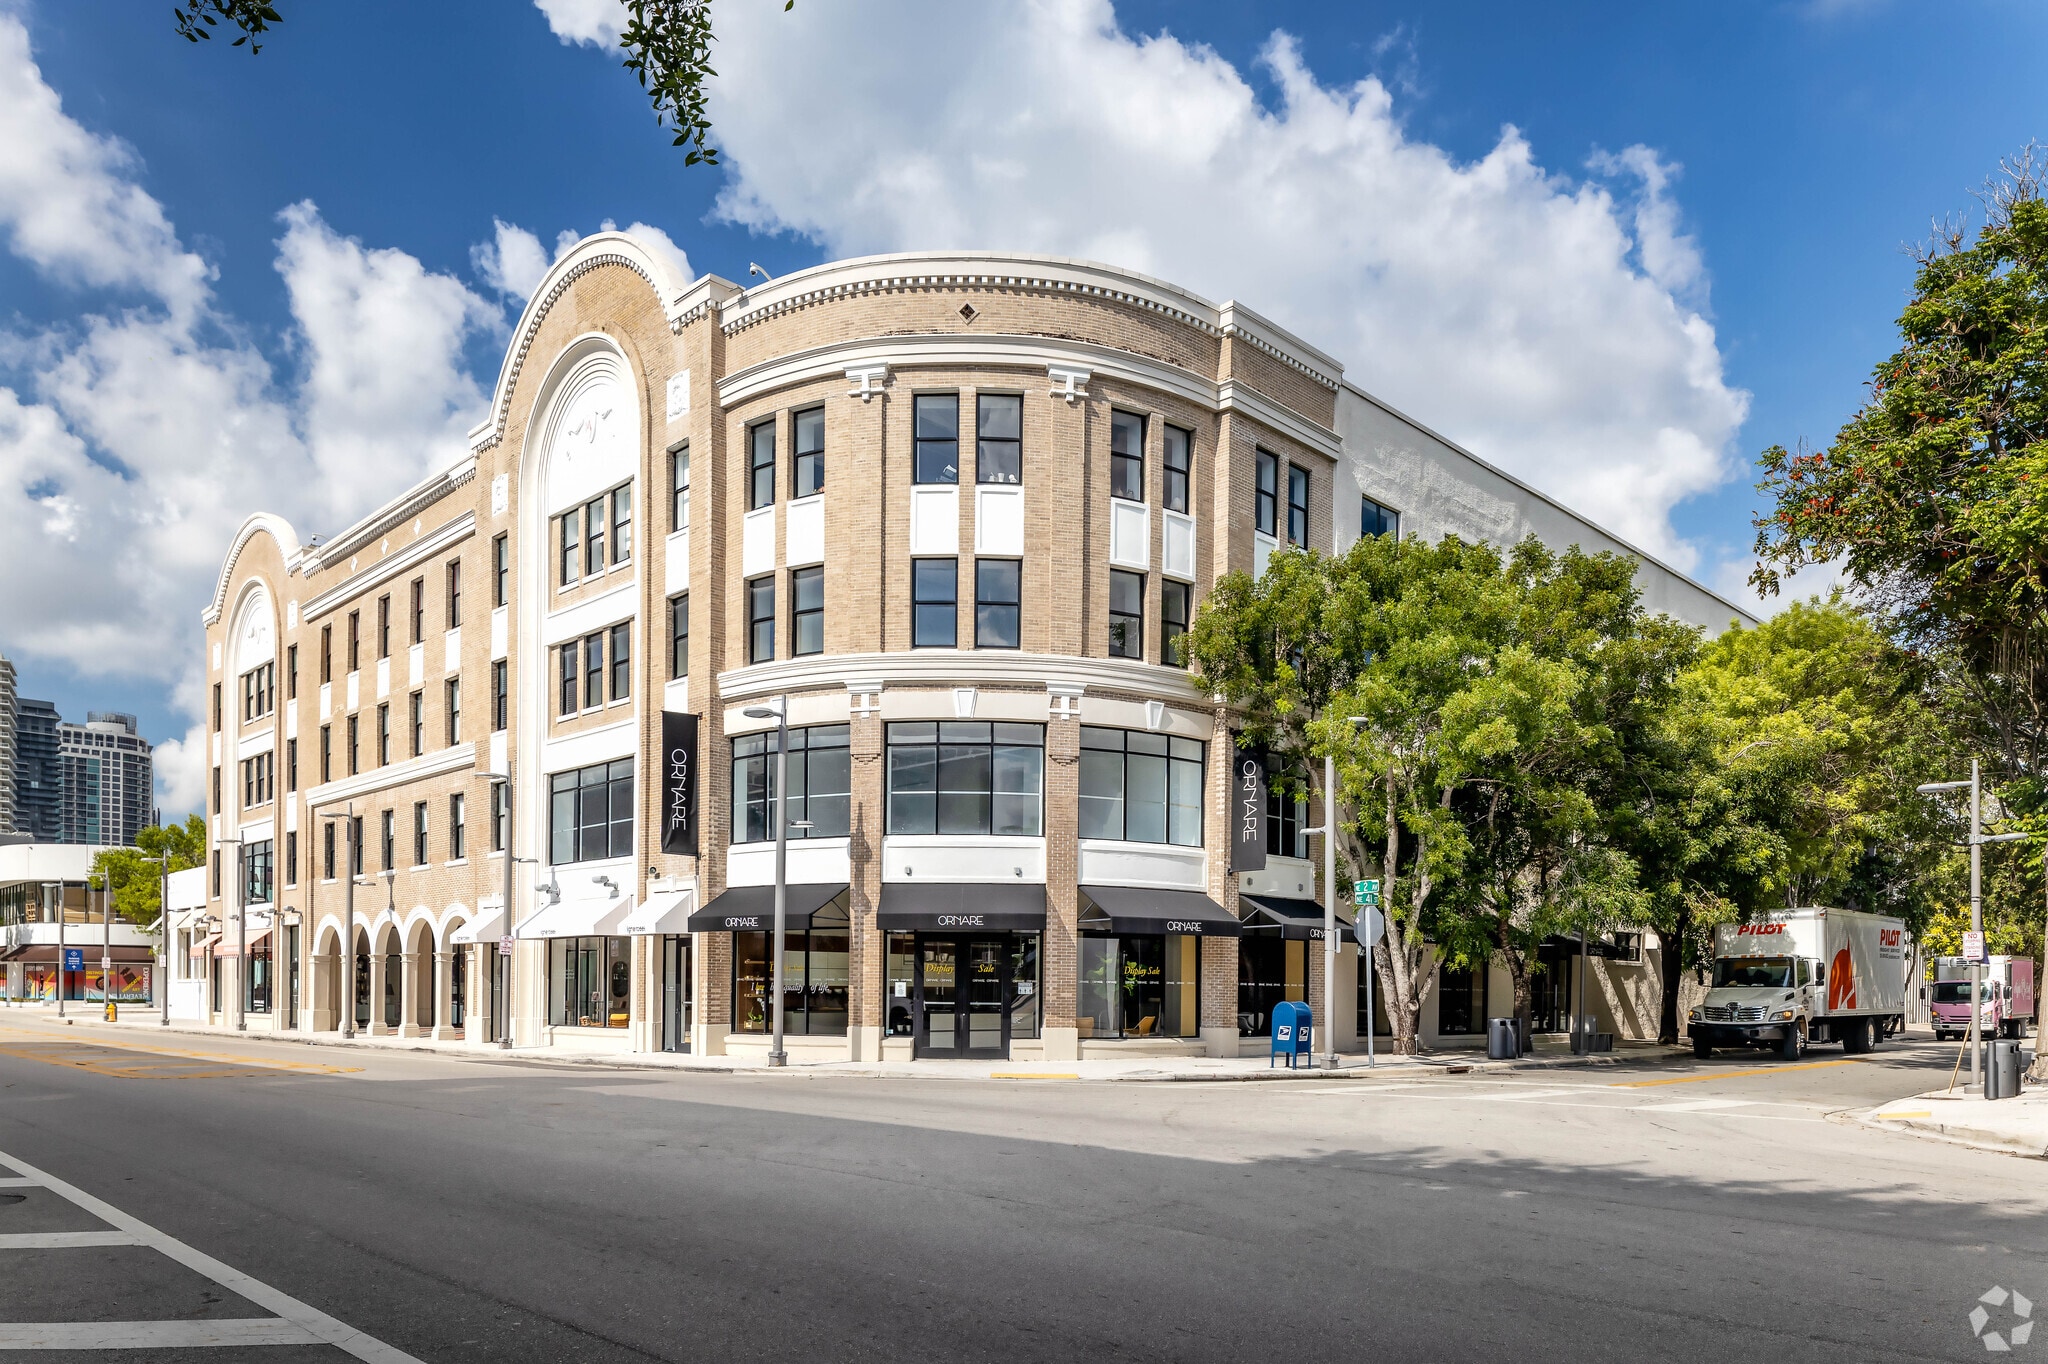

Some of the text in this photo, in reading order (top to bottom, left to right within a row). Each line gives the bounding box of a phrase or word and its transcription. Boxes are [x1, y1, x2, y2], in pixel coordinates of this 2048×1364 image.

[671, 748, 687, 830] ORNARE
[1243, 760, 1257, 842] ORNARE
[1363, 882, 1368, 891] 2
[725, 917, 759, 927] ORNARE
[937, 915, 984, 926] ORNARE
[1167, 921, 1202, 932] ORNARE
[1737, 924, 1787, 936] PILOT
[1880, 928, 1901, 947] PILOT
[926, 963, 995, 975] Display Sale
[1123, 966, 1160, 977] Display Sale
[810, 983, 818, 994] of
